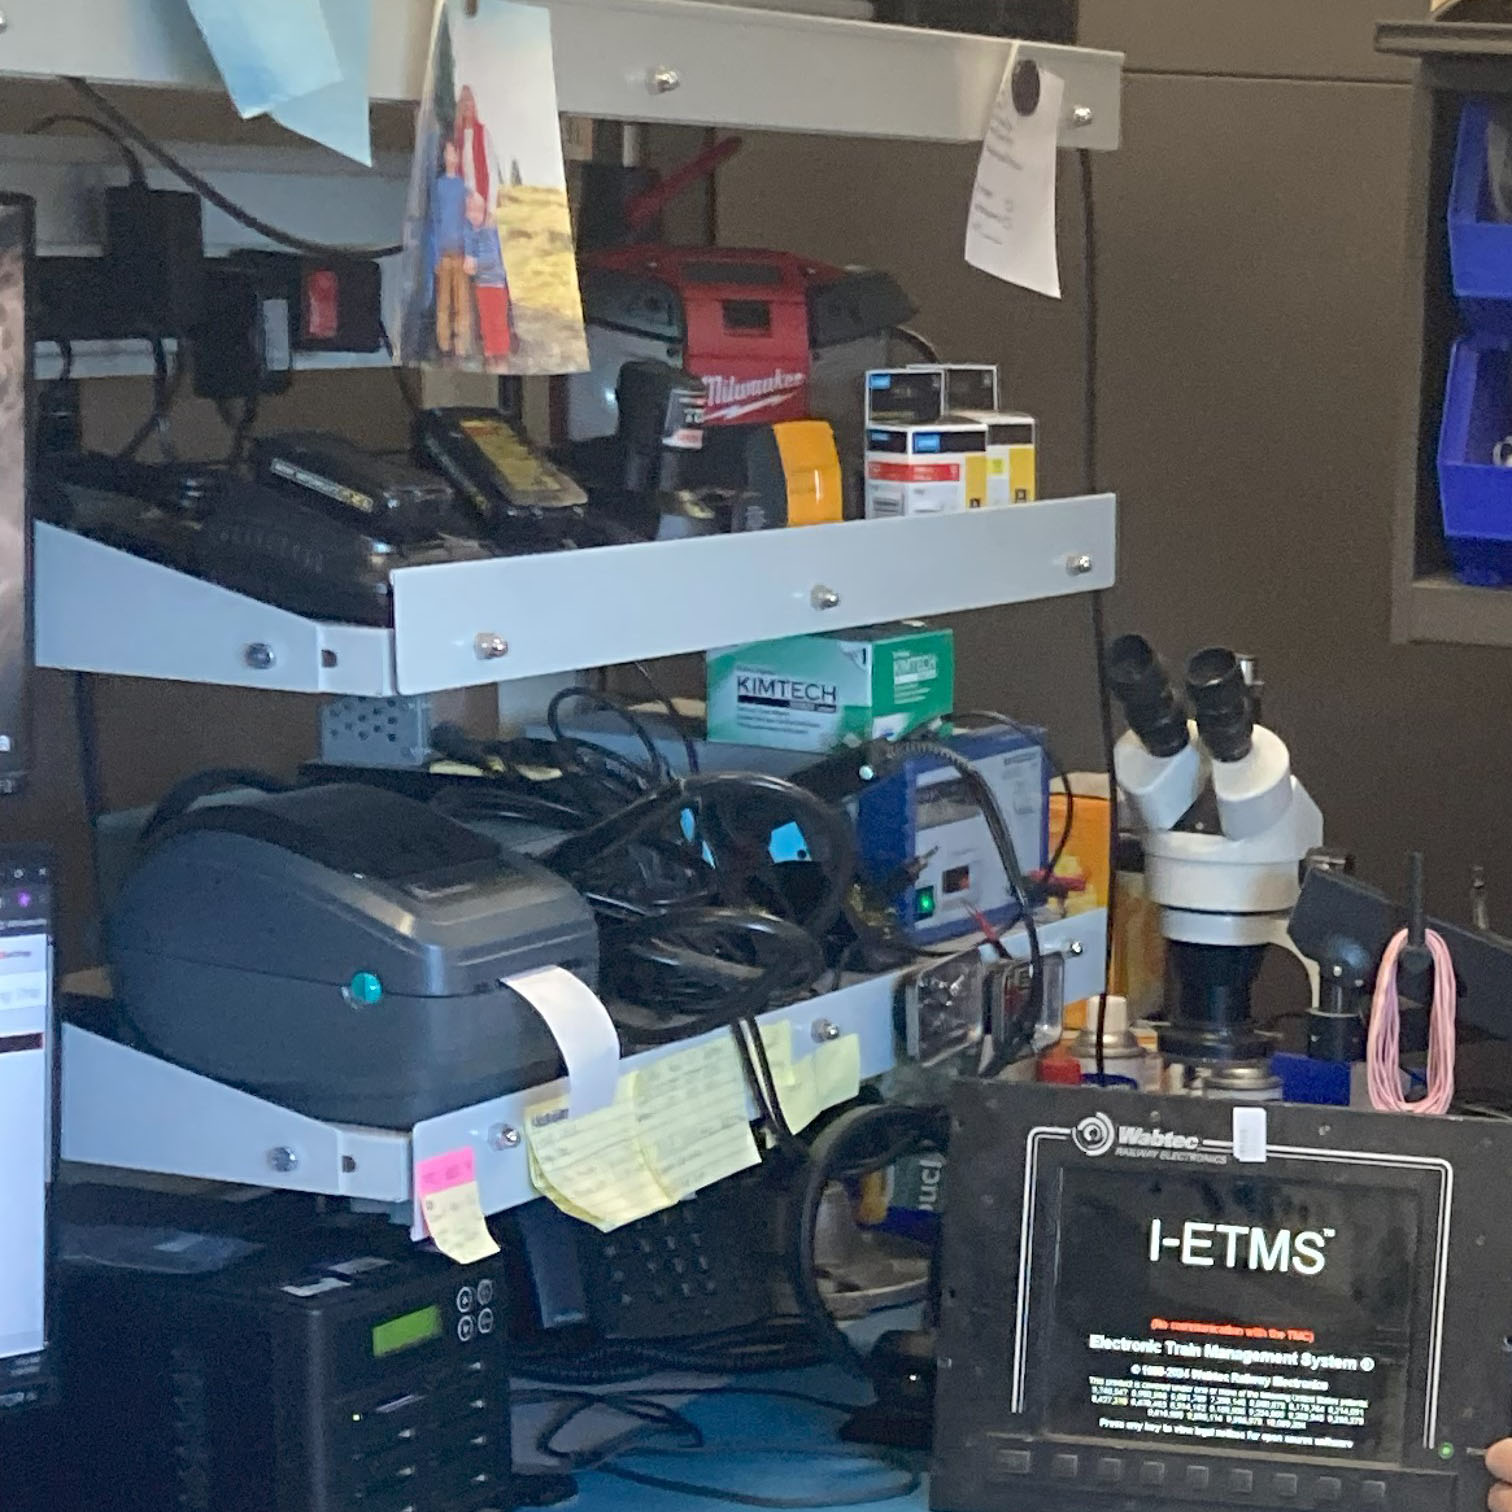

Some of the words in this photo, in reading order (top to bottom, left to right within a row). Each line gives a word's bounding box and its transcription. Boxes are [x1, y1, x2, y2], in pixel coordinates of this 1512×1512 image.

[736, 674, 837, 703] KIMTECH
[1118, 1126, 1199, 1150] Wabtec
[1089, 1333, 1162, 1354] Electronic
[1164, 1340, 1201, 1357] Train
[1203, 1343, 1298, 1365] Management
[1300, 1352, 1358, 1370] System
[1231, 1372, 1271, 1388] Railway
[1272, 1375, 1328, 1391] Electronics
